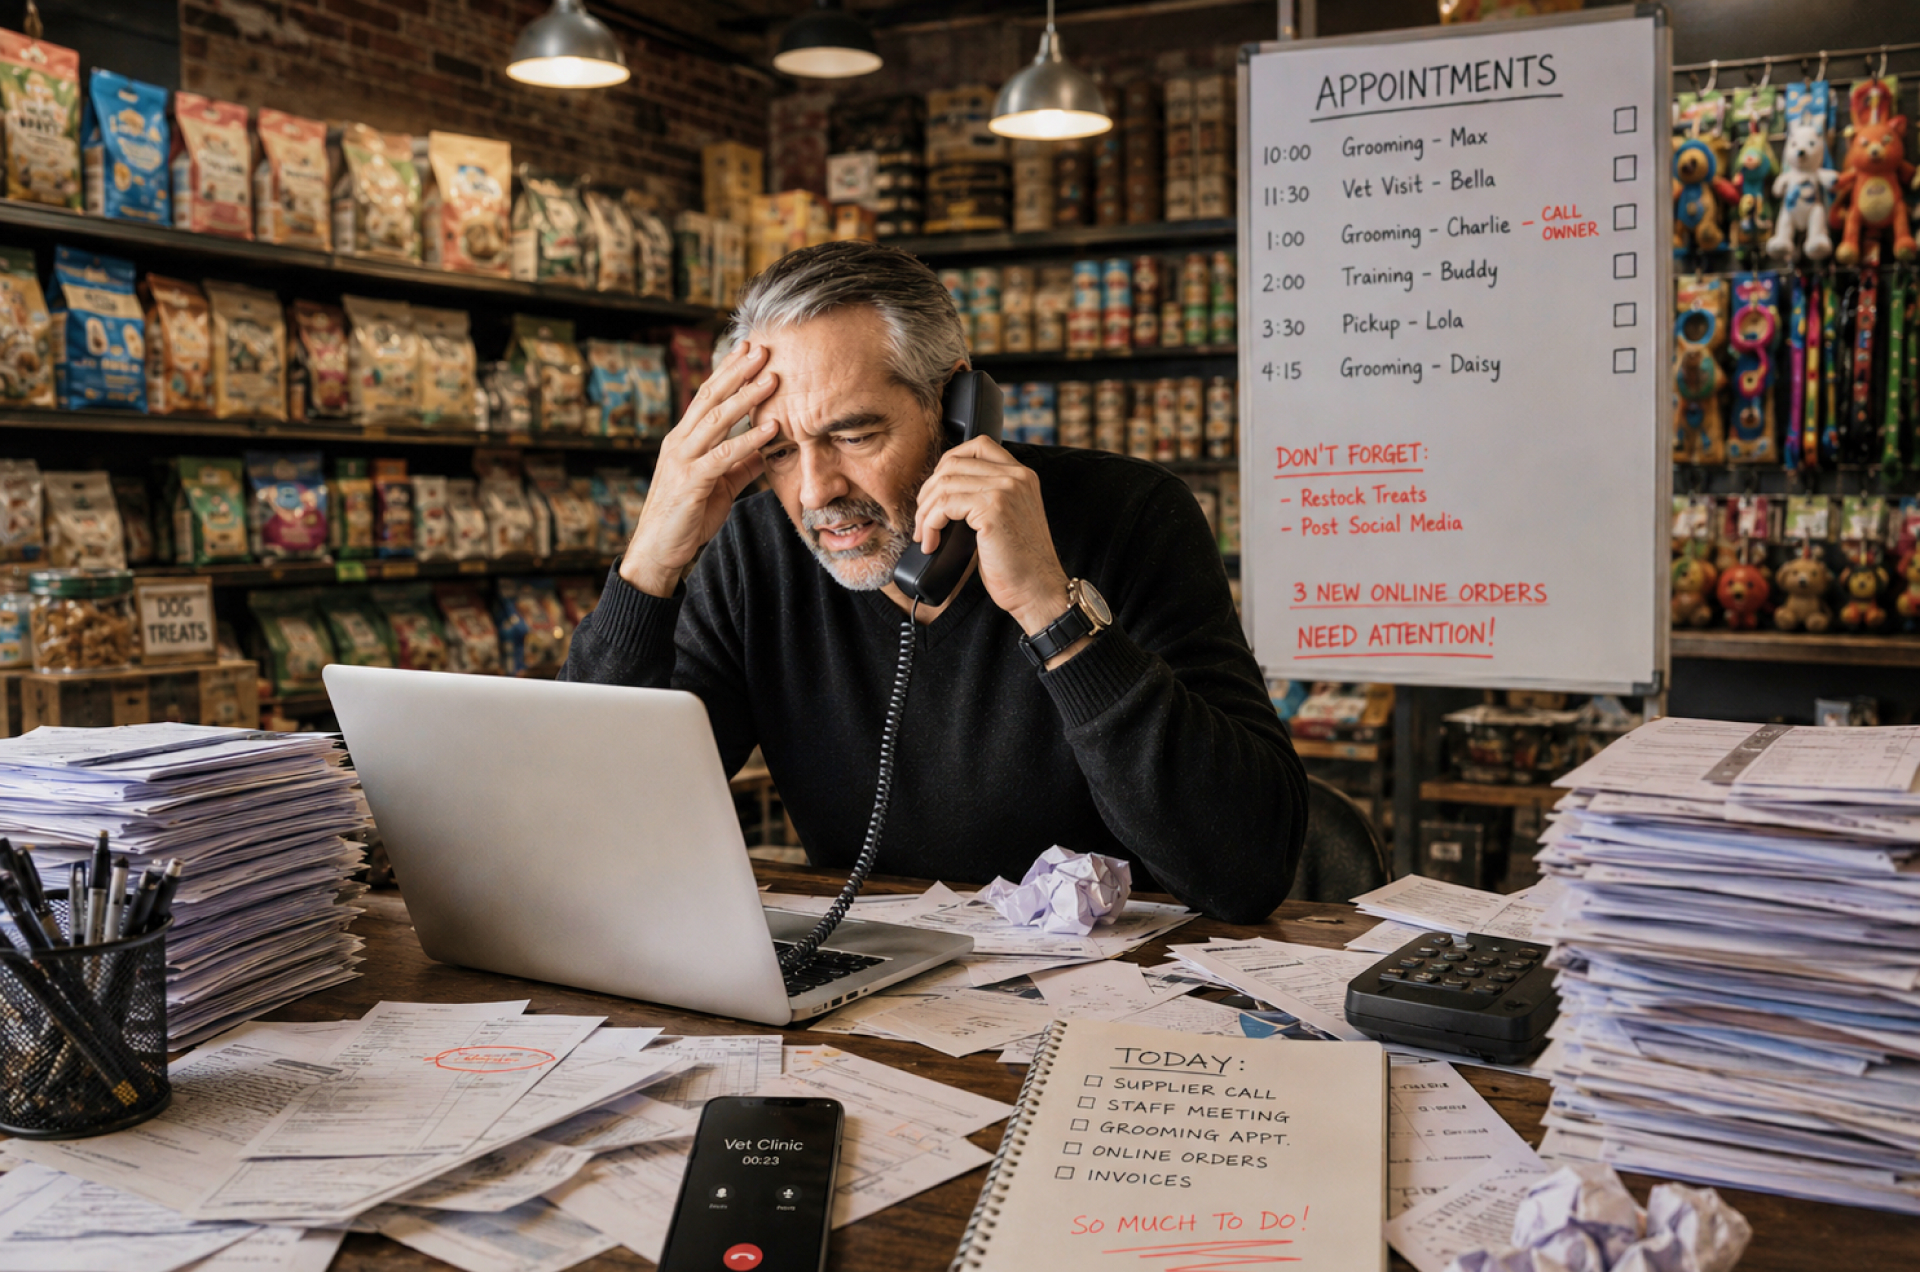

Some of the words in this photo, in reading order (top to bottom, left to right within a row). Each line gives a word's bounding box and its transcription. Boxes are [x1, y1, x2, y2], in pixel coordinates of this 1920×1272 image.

[1316, 54, 1557, 111] APPOINTMENTS
[1264, 145, 1311, 165] 10:00
[1342, 136, 1423, 161] Grooming
[1451, 126, 1487, 147] Max
[1265, 185, 1309, 206] 11:30
[1343, 179, 1372, 198] Vet
[1381, 174, 1422, 195] Visit
[1451, 168, 1496, 191] Bella
[1541, 203, 1583, 222] CALL
[1268, 231, 1304, 250] 1:00
[1341, 224, 1421, 249] Grooming
[1447, 215, 1511, 237] Charlie
[1542, 220, 1600, 241] OWNER
[1263, 273, 1305, 292] 2:00
[1342, 266, 1413, 292] Training
[1441, 259, 1498, 289] Buddy
[1263, 319, 1305, 338] 3:30
[1343, 313, 1400, 339] Pickup
[1427, 309, 1464, 330] Lola
[1262, 361, 1302, 381] 4:15
[1340, 357, 1422, 384] Grooming
[1451, 353, 1501, 383] Daisy
[1275, 442, 1339, 470] DON'T
[1348, 441, 1428, 465] FORGET:
[1301, 485, 1366, 508] Restock
[1372, 484, 1427, 504] Treats
[1301, 516, 1339, 536] Post
[1349, 513, 1401, 535] Social
[1410, 511, 1463, 532] Media
[1293, 582, 1307, 603] 3
[1317, 582, 1361, 602] NEW
[1370, 582, 1449, 602] ONLINE
[1459, 582, 1548, 603] ORDERS
[157, 597, 192, 617] DOG
[148, 623, 208, 644] TREATS
[1297, 624, 1358, 650] NEED
[1368, 616, 1496, 647] ATTENTION!
[1114, 1047, 1245, 1073] TODAY:
[1225, 1087, 1276, 1100] CALL
[1107, 1099, 1175, 1114] STAFF
[1187, 1106, 1290, 1123] MEETING
[725, 1139, 752, 1150] Vet
[757, 1139, 803, 1150] Clinic
[1100, 1121, 1219, 1142] GROOMING
[1229, 1131, 1290, 1145] APPT.
[742, 1156, 779, 1165] 00:23
[1092, 1145, 1171, 1162] ONLINE
[1181, 1152, 1267, 1168] ORDERS
[1088, 1169, 1191, 1188] INVOICES
[1070, 1214, 1105, 1235] SO
[1116, 1213, 1197, 1234] MUCH
[1211, 1211, 1244, 1232] TO
[1259, 1203, 1310, 1232] DO!
